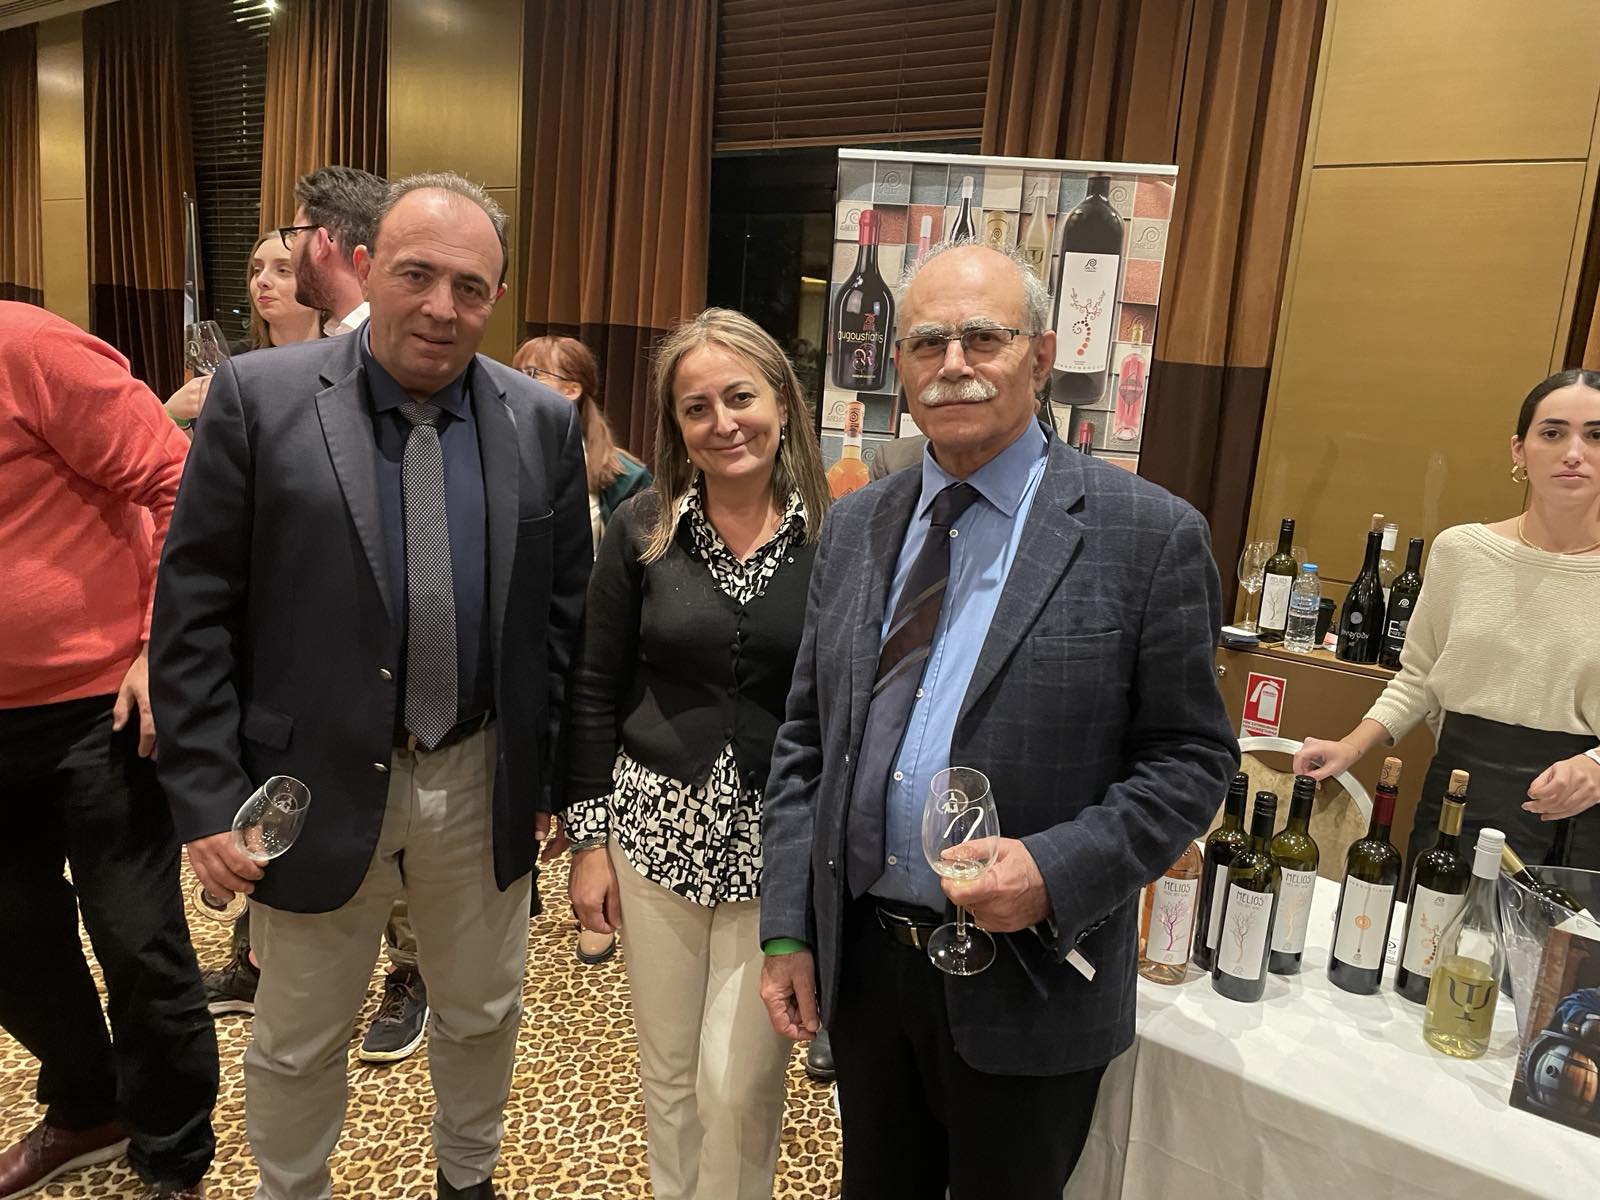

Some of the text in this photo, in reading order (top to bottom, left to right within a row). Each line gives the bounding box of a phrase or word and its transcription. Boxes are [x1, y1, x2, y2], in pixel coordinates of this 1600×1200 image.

[1285, 872, 1312, 886] MELIOS
[1163, 880, 1191, 894] MELIOS
[1235, 890, 1265, 907] MELIOS
